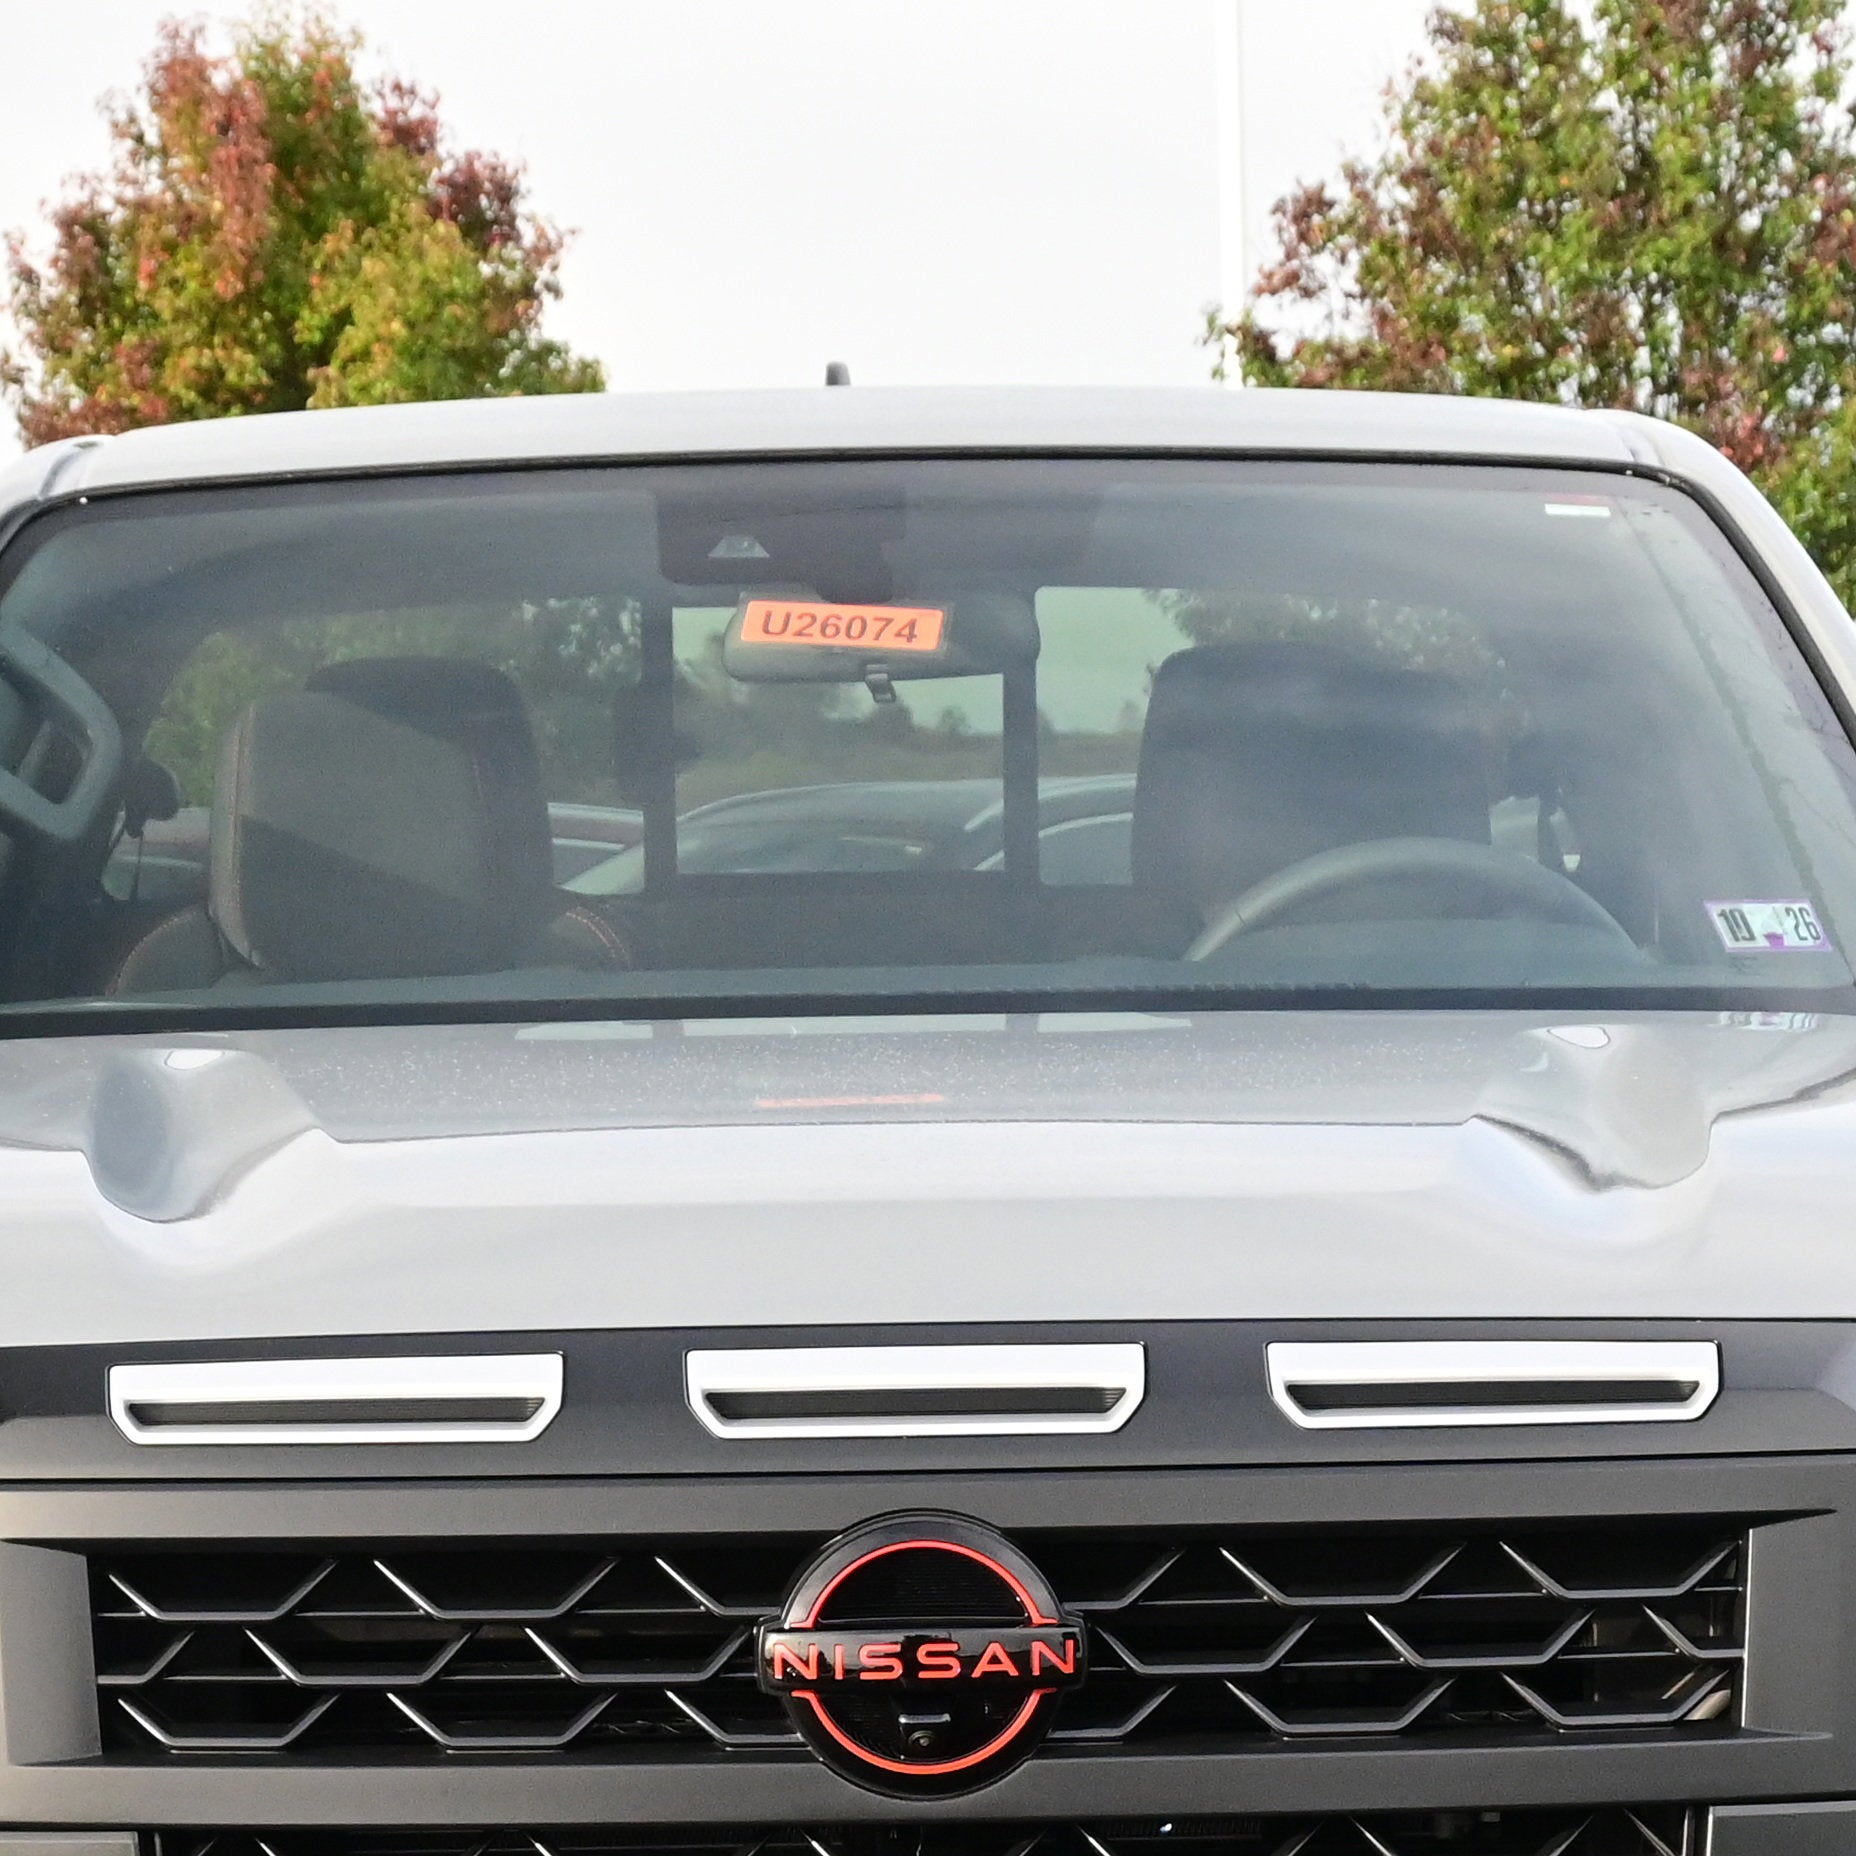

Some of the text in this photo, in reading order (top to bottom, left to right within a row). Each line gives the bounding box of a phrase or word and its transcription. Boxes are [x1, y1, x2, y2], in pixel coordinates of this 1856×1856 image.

[761, 610, 918, 643] U26074
[1784, 906, 1822, 941] 26
[772, 1638, 1075, 1680] NISSAN
